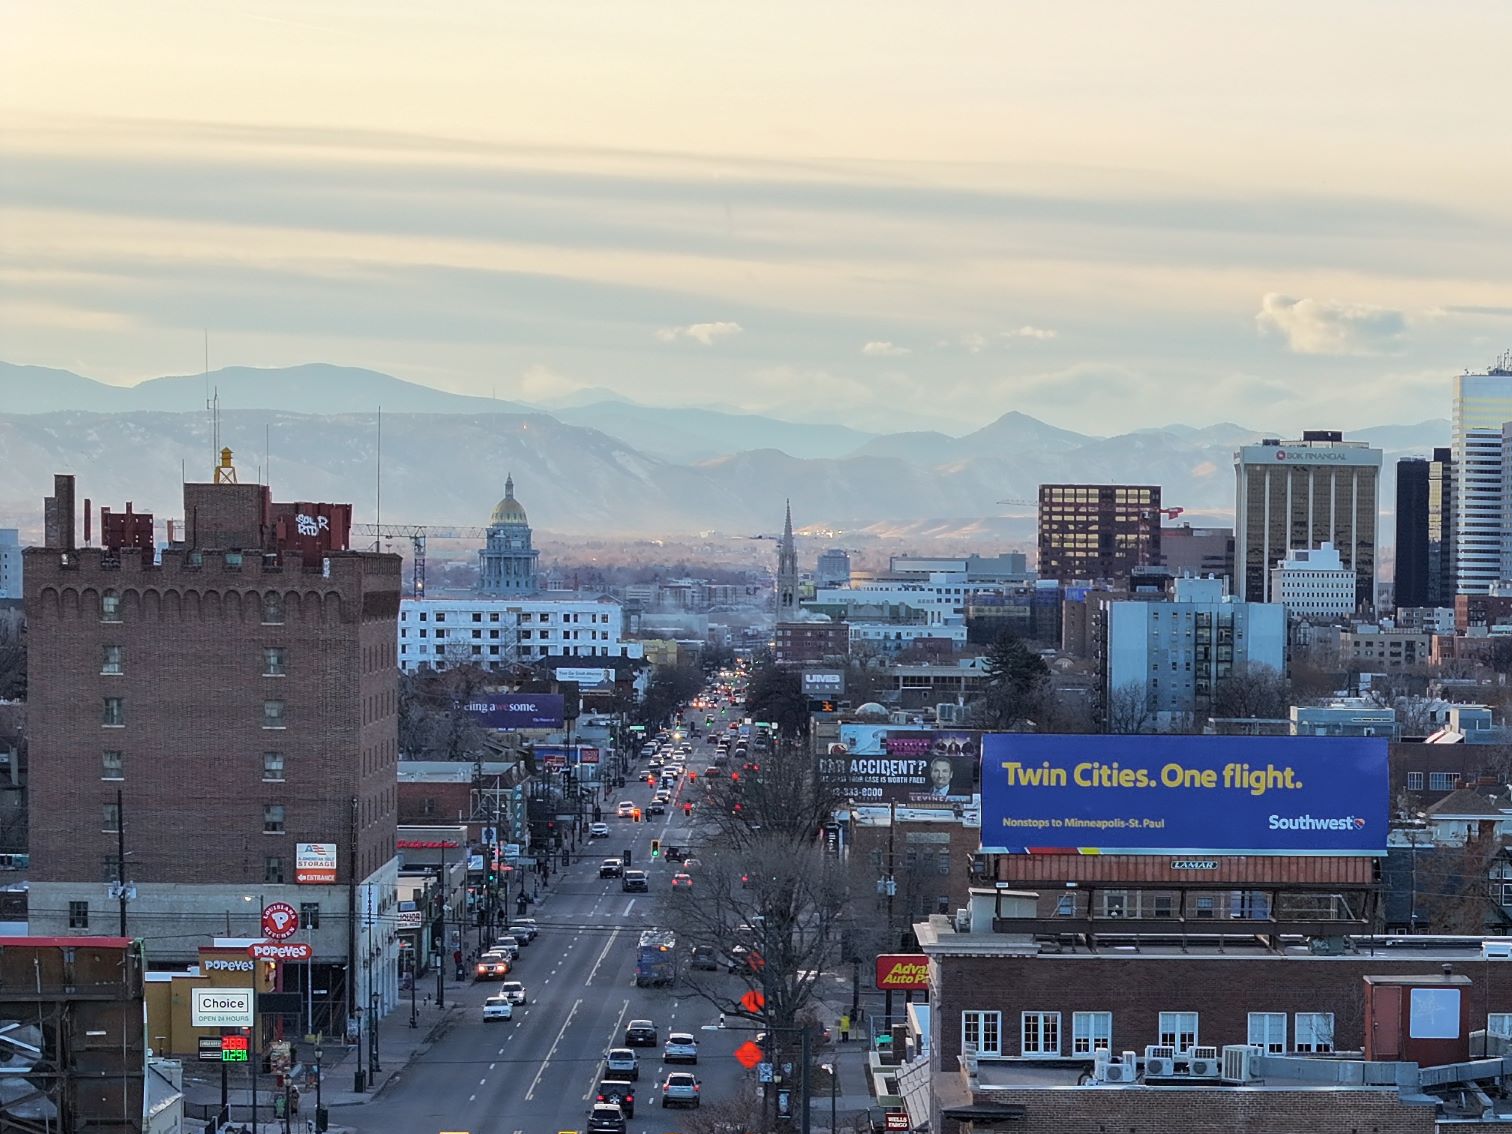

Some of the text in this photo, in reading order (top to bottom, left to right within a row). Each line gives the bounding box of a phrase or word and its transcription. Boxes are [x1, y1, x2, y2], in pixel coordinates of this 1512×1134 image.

[805, 674, 840, 683] UMB
[850, 760, 927, 775] ACCIDENT?
[887, 776, 908, 784] WORTH
[1002, 761, 1303, 796] Twin Cities. One flight.
[1002, 817, 1165, 830] Nonstops to Minneapolis-St. Paul
[1269, 814, 1354, 830] Southwest
[306, 874, 335, 882] ENTRANCE
[263, 905, 296, 920] LOUISIANA
[883, 974, 913, 984] Auto
[203, 998, 244, 1009] Choice
